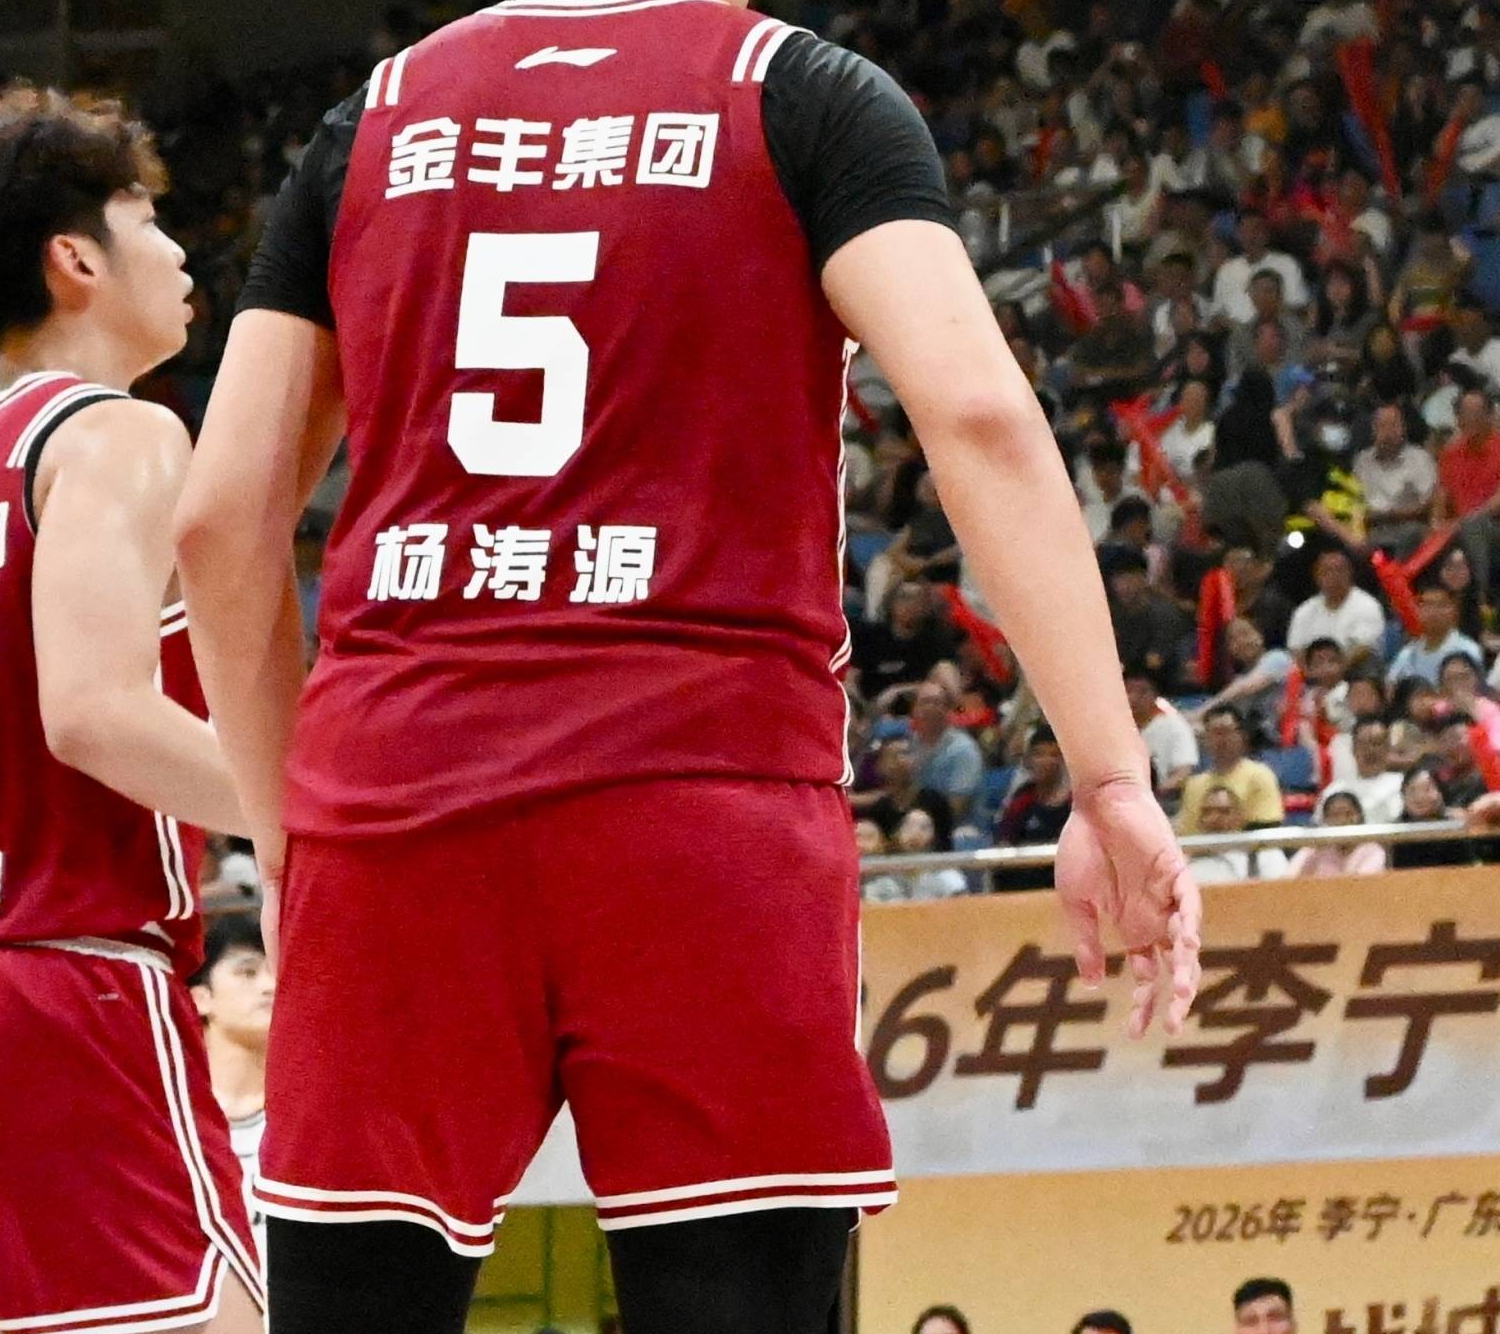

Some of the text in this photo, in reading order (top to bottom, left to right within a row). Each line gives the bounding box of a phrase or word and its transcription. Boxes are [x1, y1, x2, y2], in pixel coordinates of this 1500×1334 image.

[386, 113, 719, 199] 金丰集团
[447, 231, 599, 476] 5
[367, 523, 657, 603] 杨涛源
[1166, 1197, 1306, 1245] 2026年
